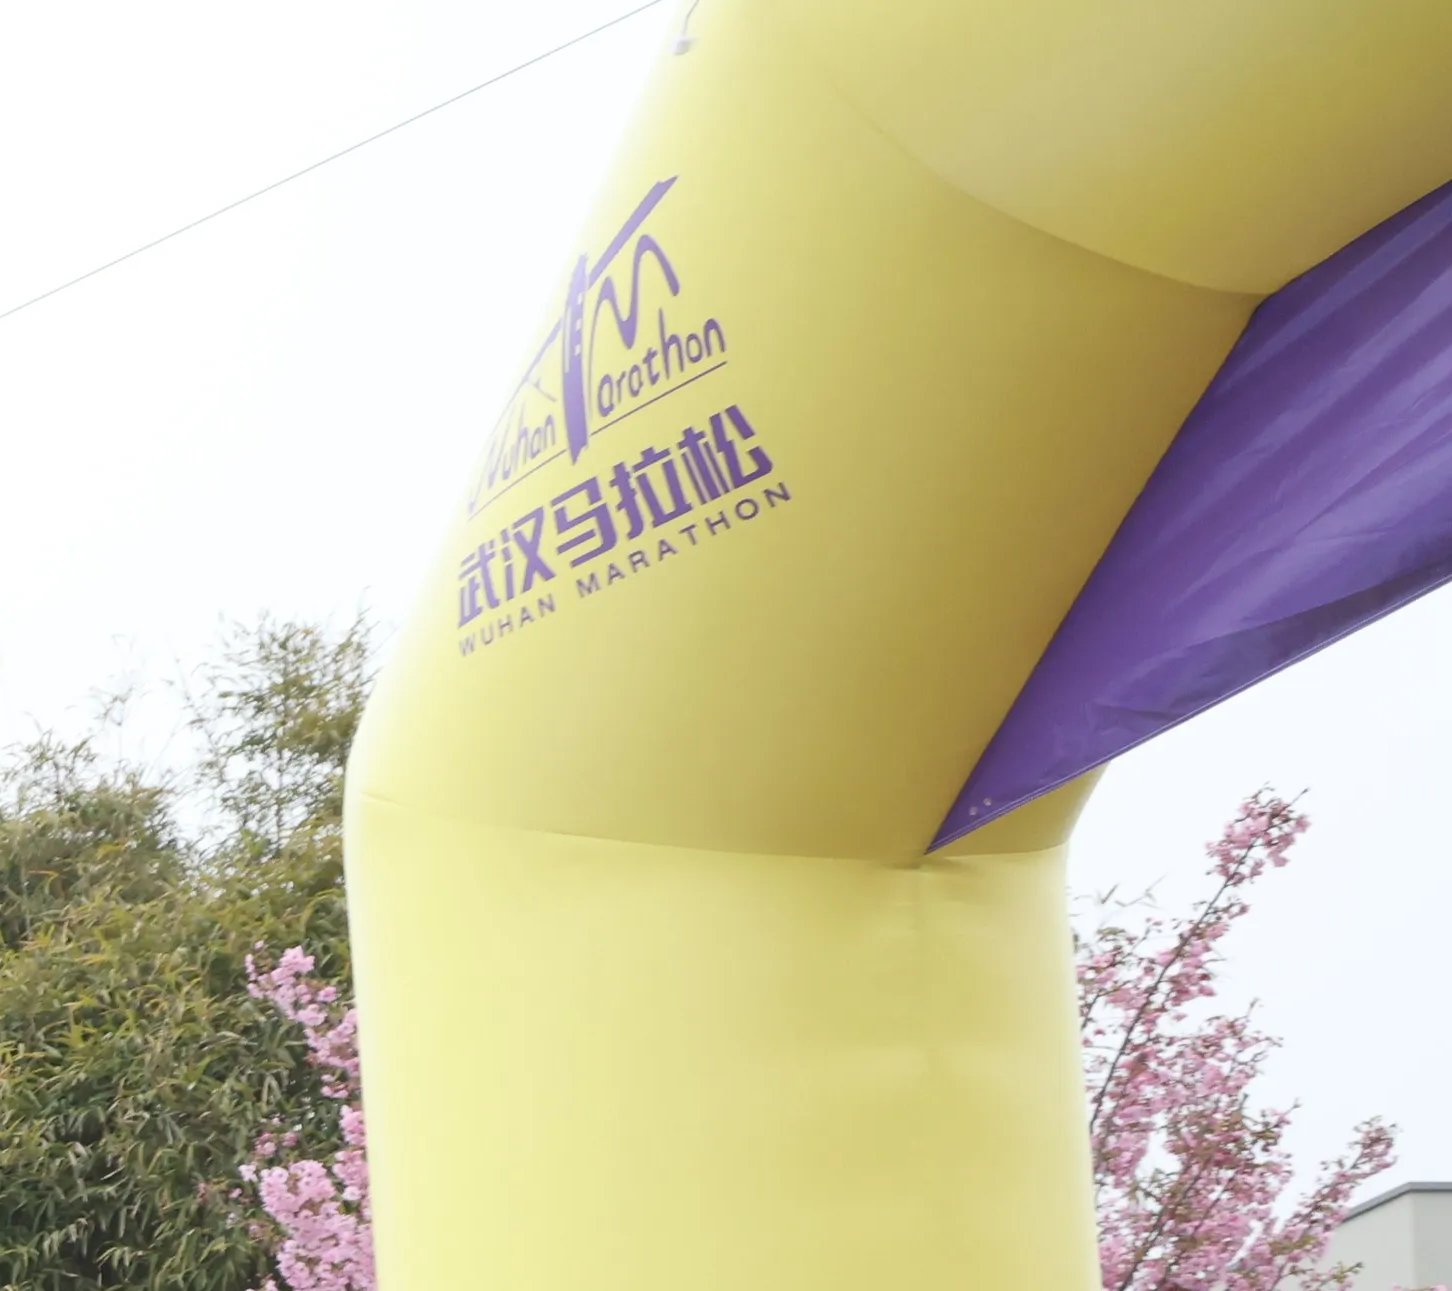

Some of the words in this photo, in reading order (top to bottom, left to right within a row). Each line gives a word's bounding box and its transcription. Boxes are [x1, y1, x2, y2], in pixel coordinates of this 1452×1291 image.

[456, 404, 774, 630] 武汉马拉松
[458, 592, 557, 658] WUHAN
[575, 480, 792, 599] MARATHON
